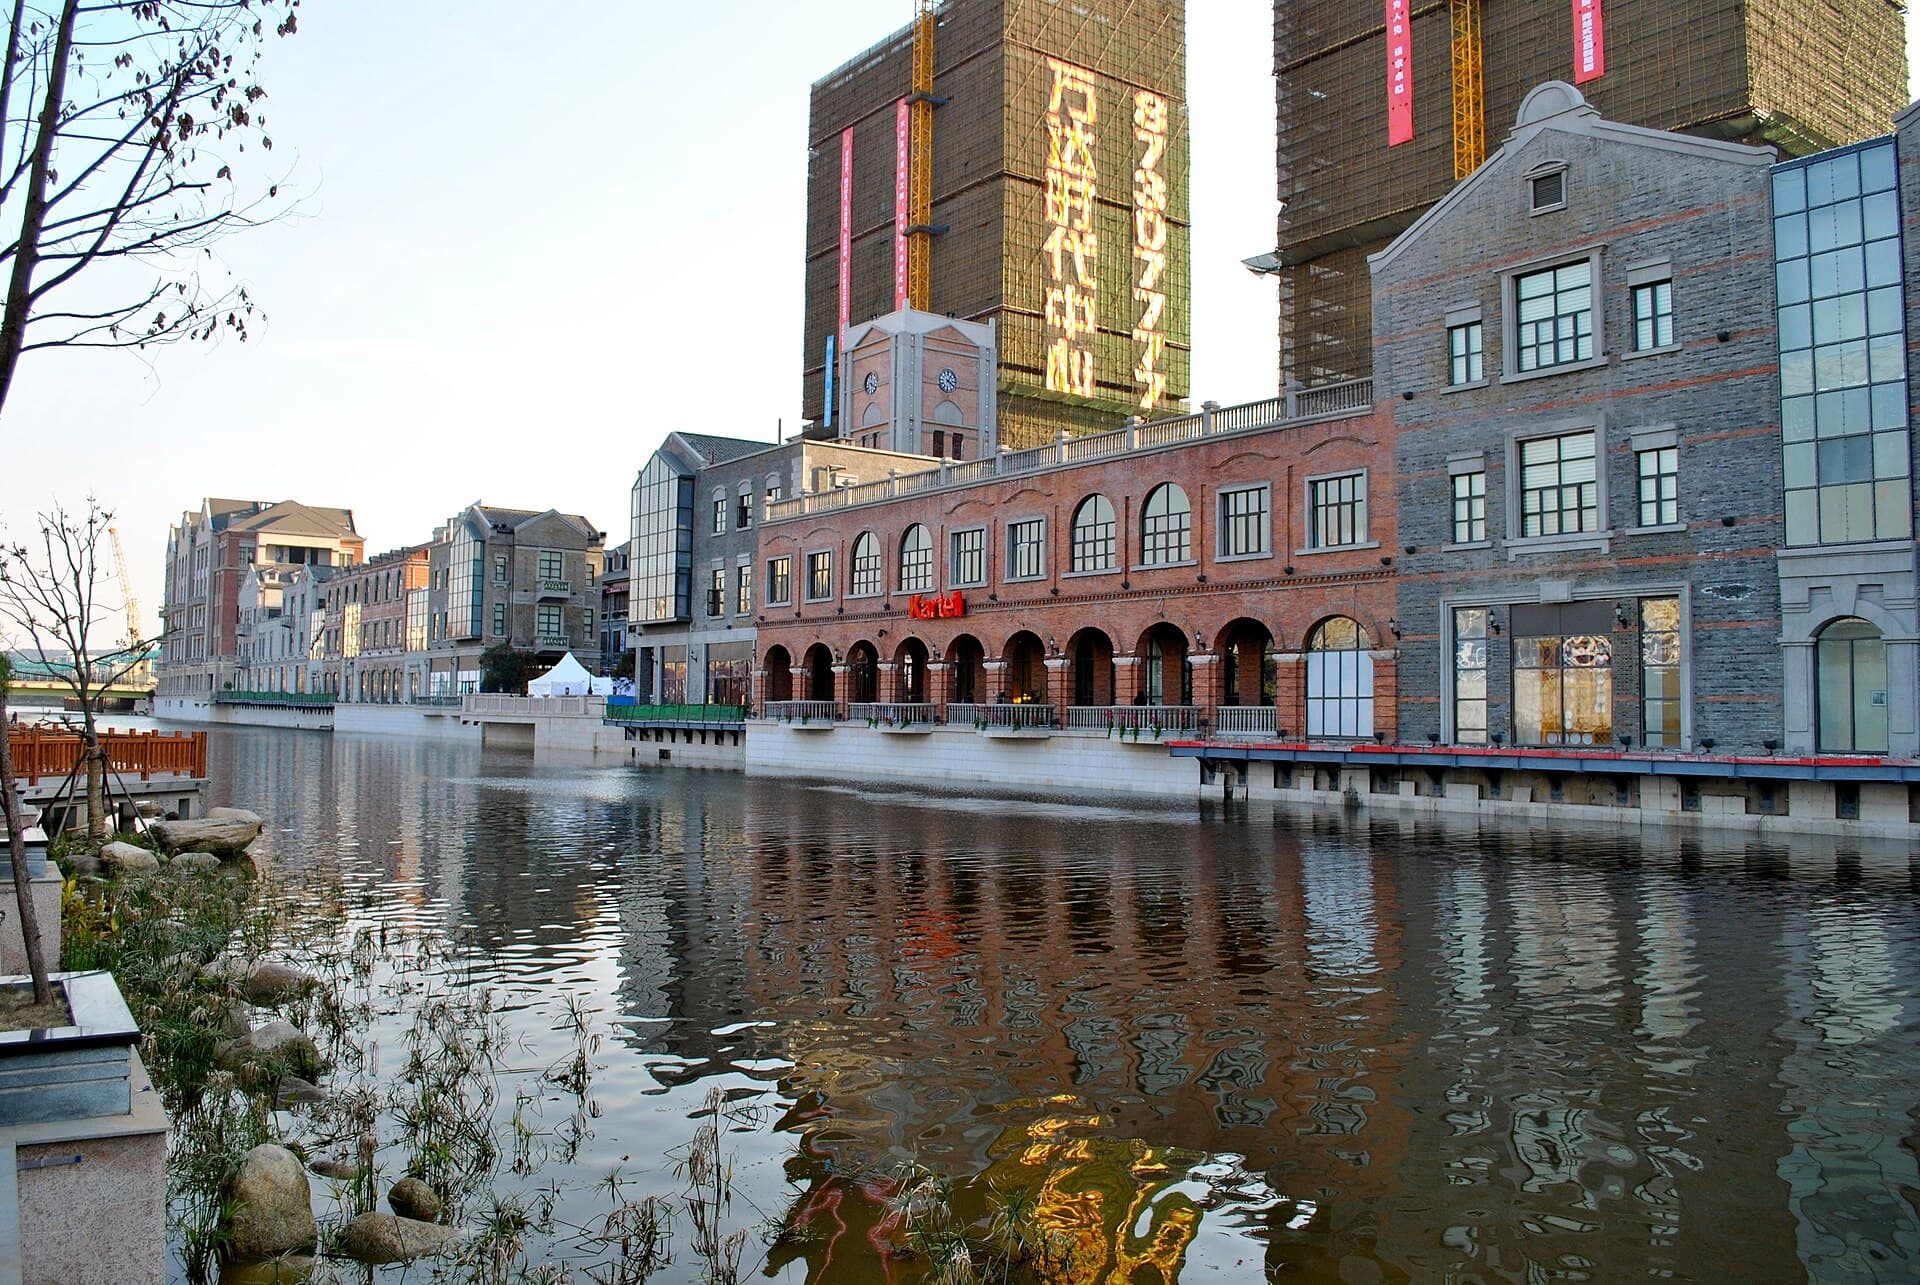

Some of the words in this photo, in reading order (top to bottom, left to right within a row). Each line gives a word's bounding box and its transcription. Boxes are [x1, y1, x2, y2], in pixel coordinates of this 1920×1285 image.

[1043, 56, 1098, 398] 万达时代中心
[1133, 90, 1168, 410] 87307777
[909, 590, 964, 619] Kartell
